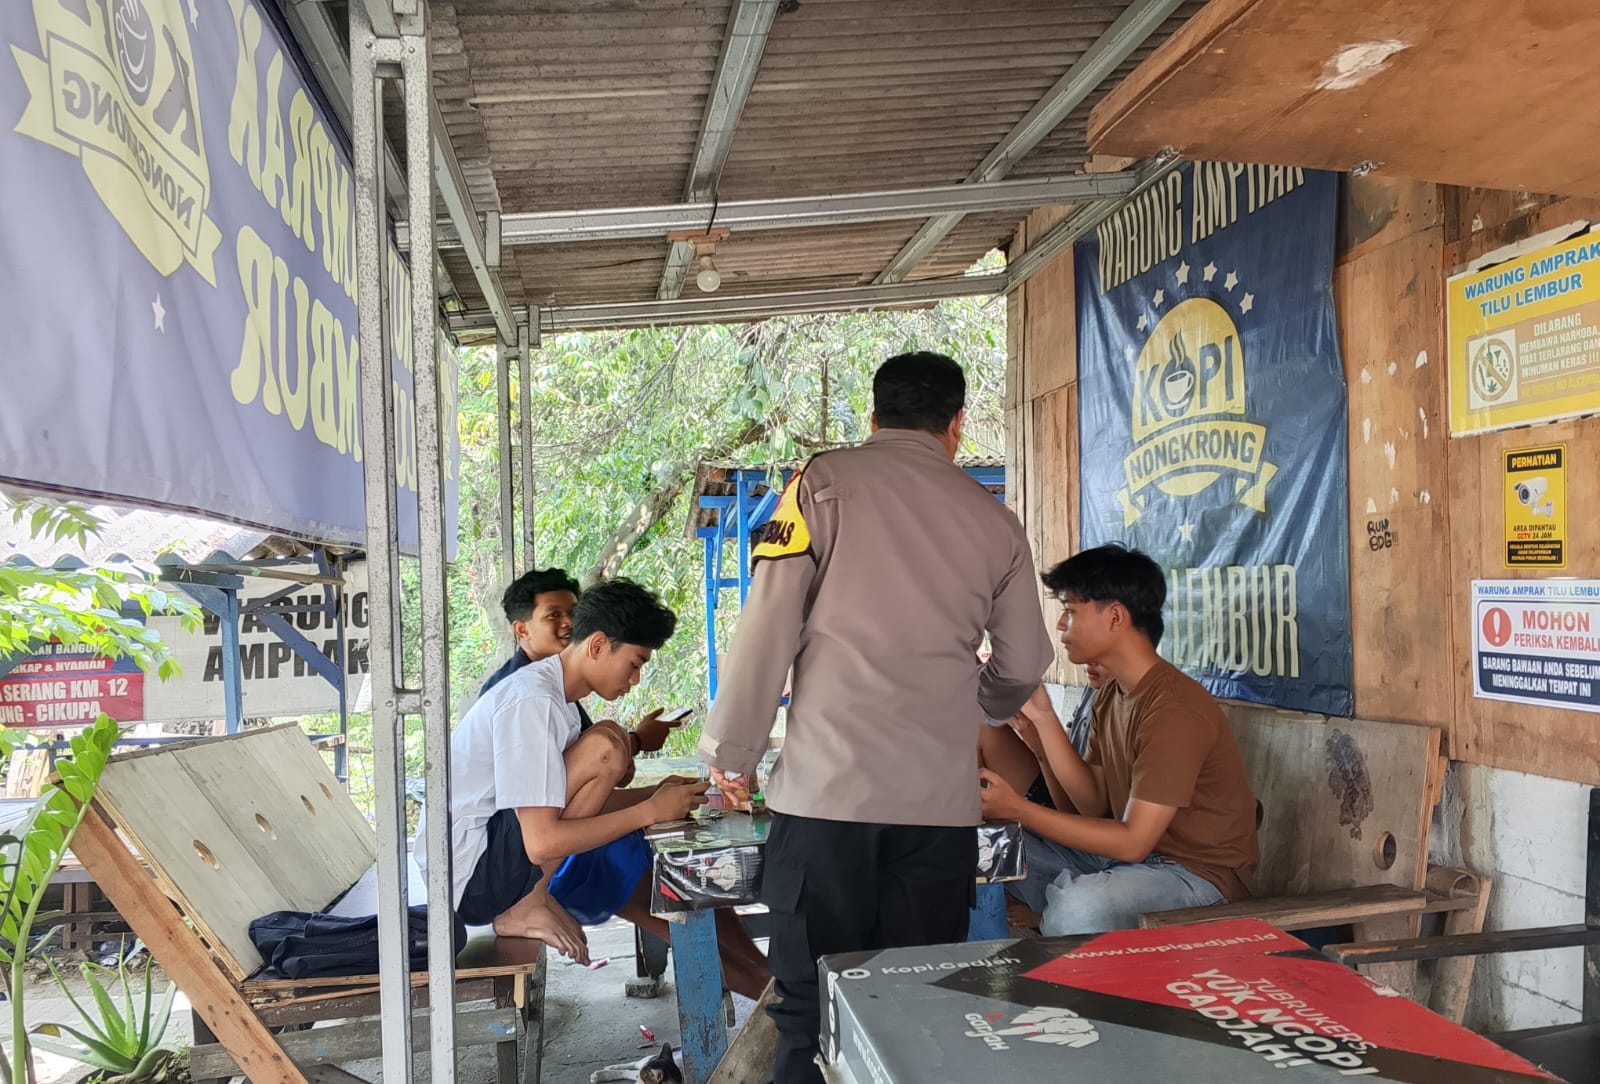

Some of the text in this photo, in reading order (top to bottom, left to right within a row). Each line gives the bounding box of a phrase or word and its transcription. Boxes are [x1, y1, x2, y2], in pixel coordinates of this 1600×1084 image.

[1097, 170, 1183, 296] WARUNG
[1464, 241, 1600, 300] WARUNG AMPRAK
[1480, 273, 1583, 318] TILU LEMBUR
[1533, 312, 1582, 337] DILARANG
[1560, 353, 1587, 370] KERAS
[1138, 334, 1236, 427] KOPI
[1128, 428, 1257, 485] NONGKRONG
[1511, 453, 1557, 469] PERHATIAN
[1477, 585, 1510, 596] WARUNG
[1512, 585, 1545, 596] AMPRAK
[1548, 586, 1567, 596] TILU
[1170, 563, 1300, 678] LEMBUR
[1522, 609, 1590, 633] MOHON
[1514, 633, 1554, 649] PERIKSA
[45, 664, 54, 673] &
[56, 660, 106, 673] NYAMAN
[1482, 656, 1511, 672] BARANG
[1512, 658, 1542, 675] BAWAAN
[1543, 661, 1564, 677] ANDA
[3, 677, 129, 702] SERANG KM. 12
[1492, 673, 1591, 698] MENINGGALKAN TEMPAT INI
[36, 700, 101, 722] CIKUPA
[1166, 980, 1316, 1070] GADJAH!
[1191, 967, 1380, 1077] YUK NGOPI
